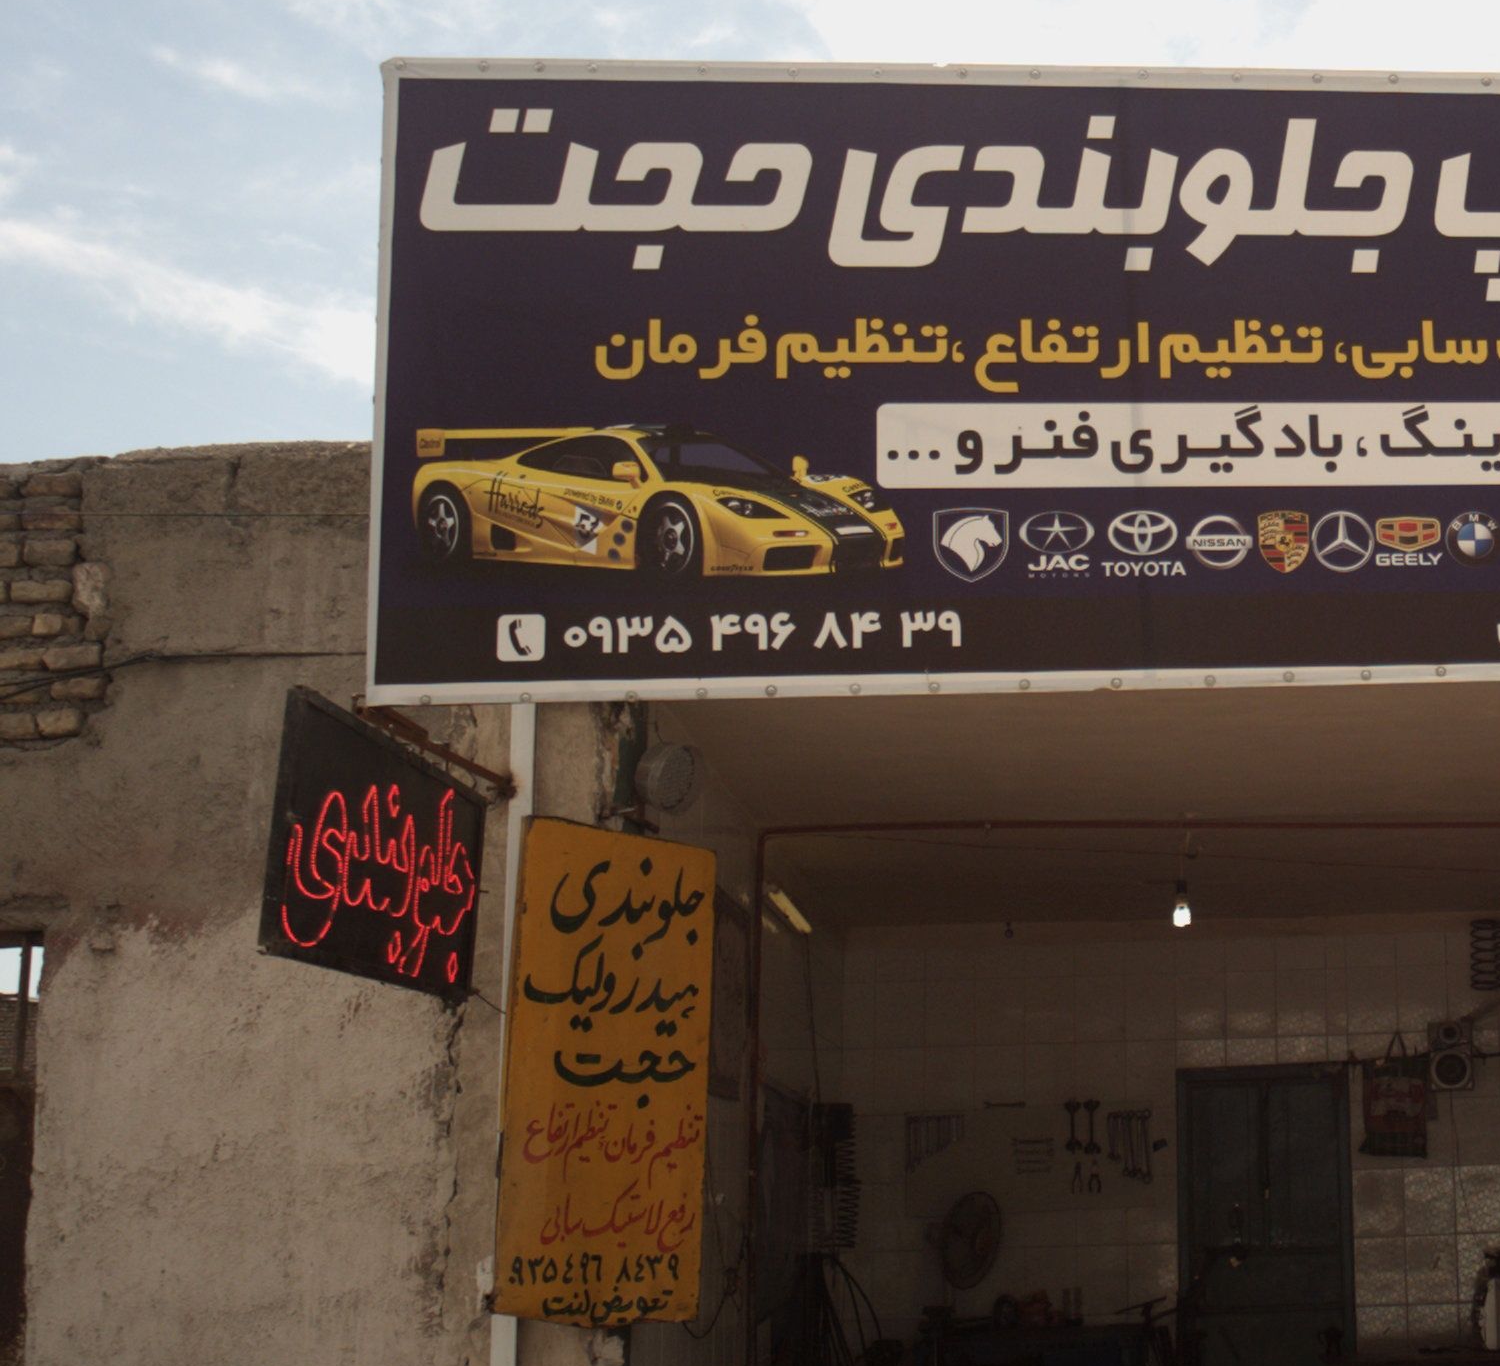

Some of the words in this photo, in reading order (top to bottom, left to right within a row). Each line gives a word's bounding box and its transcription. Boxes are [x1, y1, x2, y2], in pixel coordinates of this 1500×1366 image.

[419, 108, 813, 271] حجت
[827, 115, 1414, 274] جلوبندی
[595, 314, 768, 380] فرمان
[974, 318, 1150, 393] ارتفاع
[1159, 319, 1324, 380] تنظیم
[1192, 537, 1247, 547] NISSAN
[1450, 513, 1500, 532] BMW
[1027, 554, 1090, 571] JAC
[1101, 560, 1187, 578] TOYOTA
[1375, 551, 1443, 567] GEELY
[550, 857, 706, 961] جلوبندی
[553, 1049, 697, 1109] حجت
[648, 1103, 704, 1190] تنظیم
[581, 1178, 665, 1249] لاستیک
[656, 1191, 696, 1254] رفع
